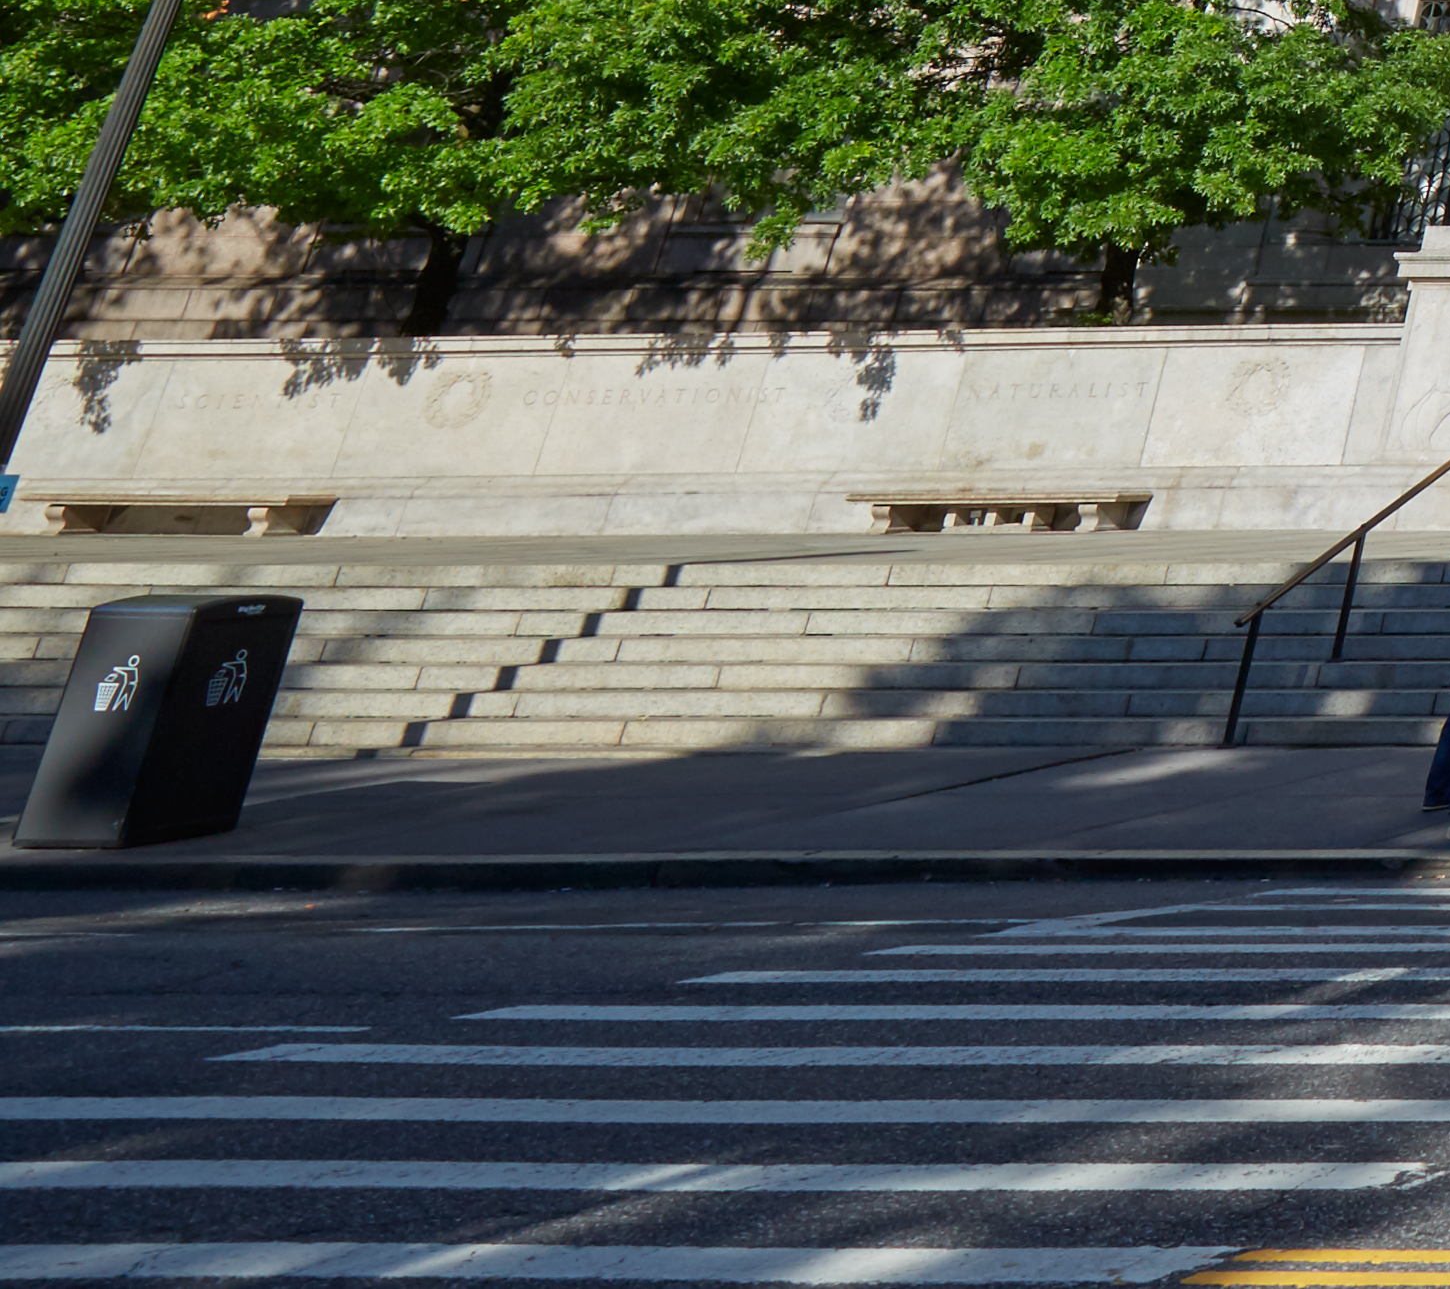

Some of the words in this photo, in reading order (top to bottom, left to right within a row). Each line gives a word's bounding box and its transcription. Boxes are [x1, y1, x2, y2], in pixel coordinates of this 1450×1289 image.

[523, 387, 787, 405] CONSERVATIONIST
[962, 382, 1150, 400] NATURALIST
[176, 393, 342, 409] SCIENTIST
